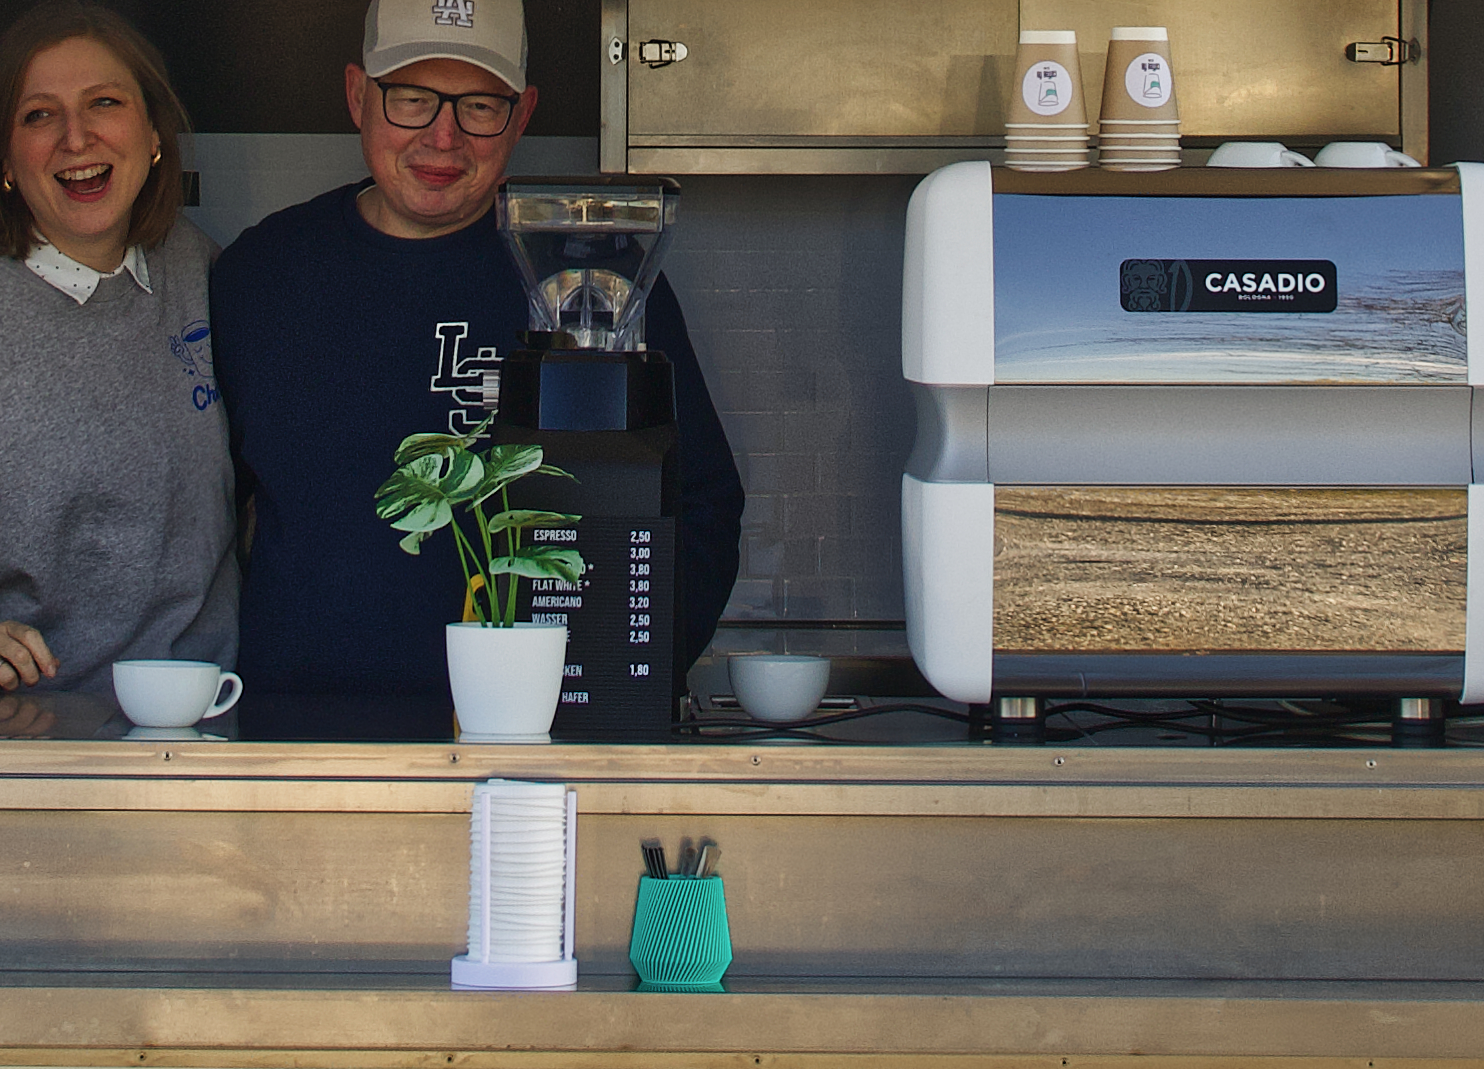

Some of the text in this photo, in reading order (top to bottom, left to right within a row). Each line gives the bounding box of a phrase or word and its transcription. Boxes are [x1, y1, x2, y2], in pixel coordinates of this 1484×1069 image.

[1205, 272, 1326, 292] CASADIO
[533, 529, 651, 543] ESPRESSO 2,50
[630, 547, 651, 560] 3,00
[629, 563, 650, 576] 3,80
[532, 579, 553, 591] FLAT
[629, 580, 650, 593] 3,80
[531, 595, 650, 609] AMERICANO 3,20
[531, 613, 650, 627] WASSER 2,50
[629, 630, 650, 643] 2,50
[629, 664, 650, 677] 1,80
[561, 692, 589, 704] HAFER
